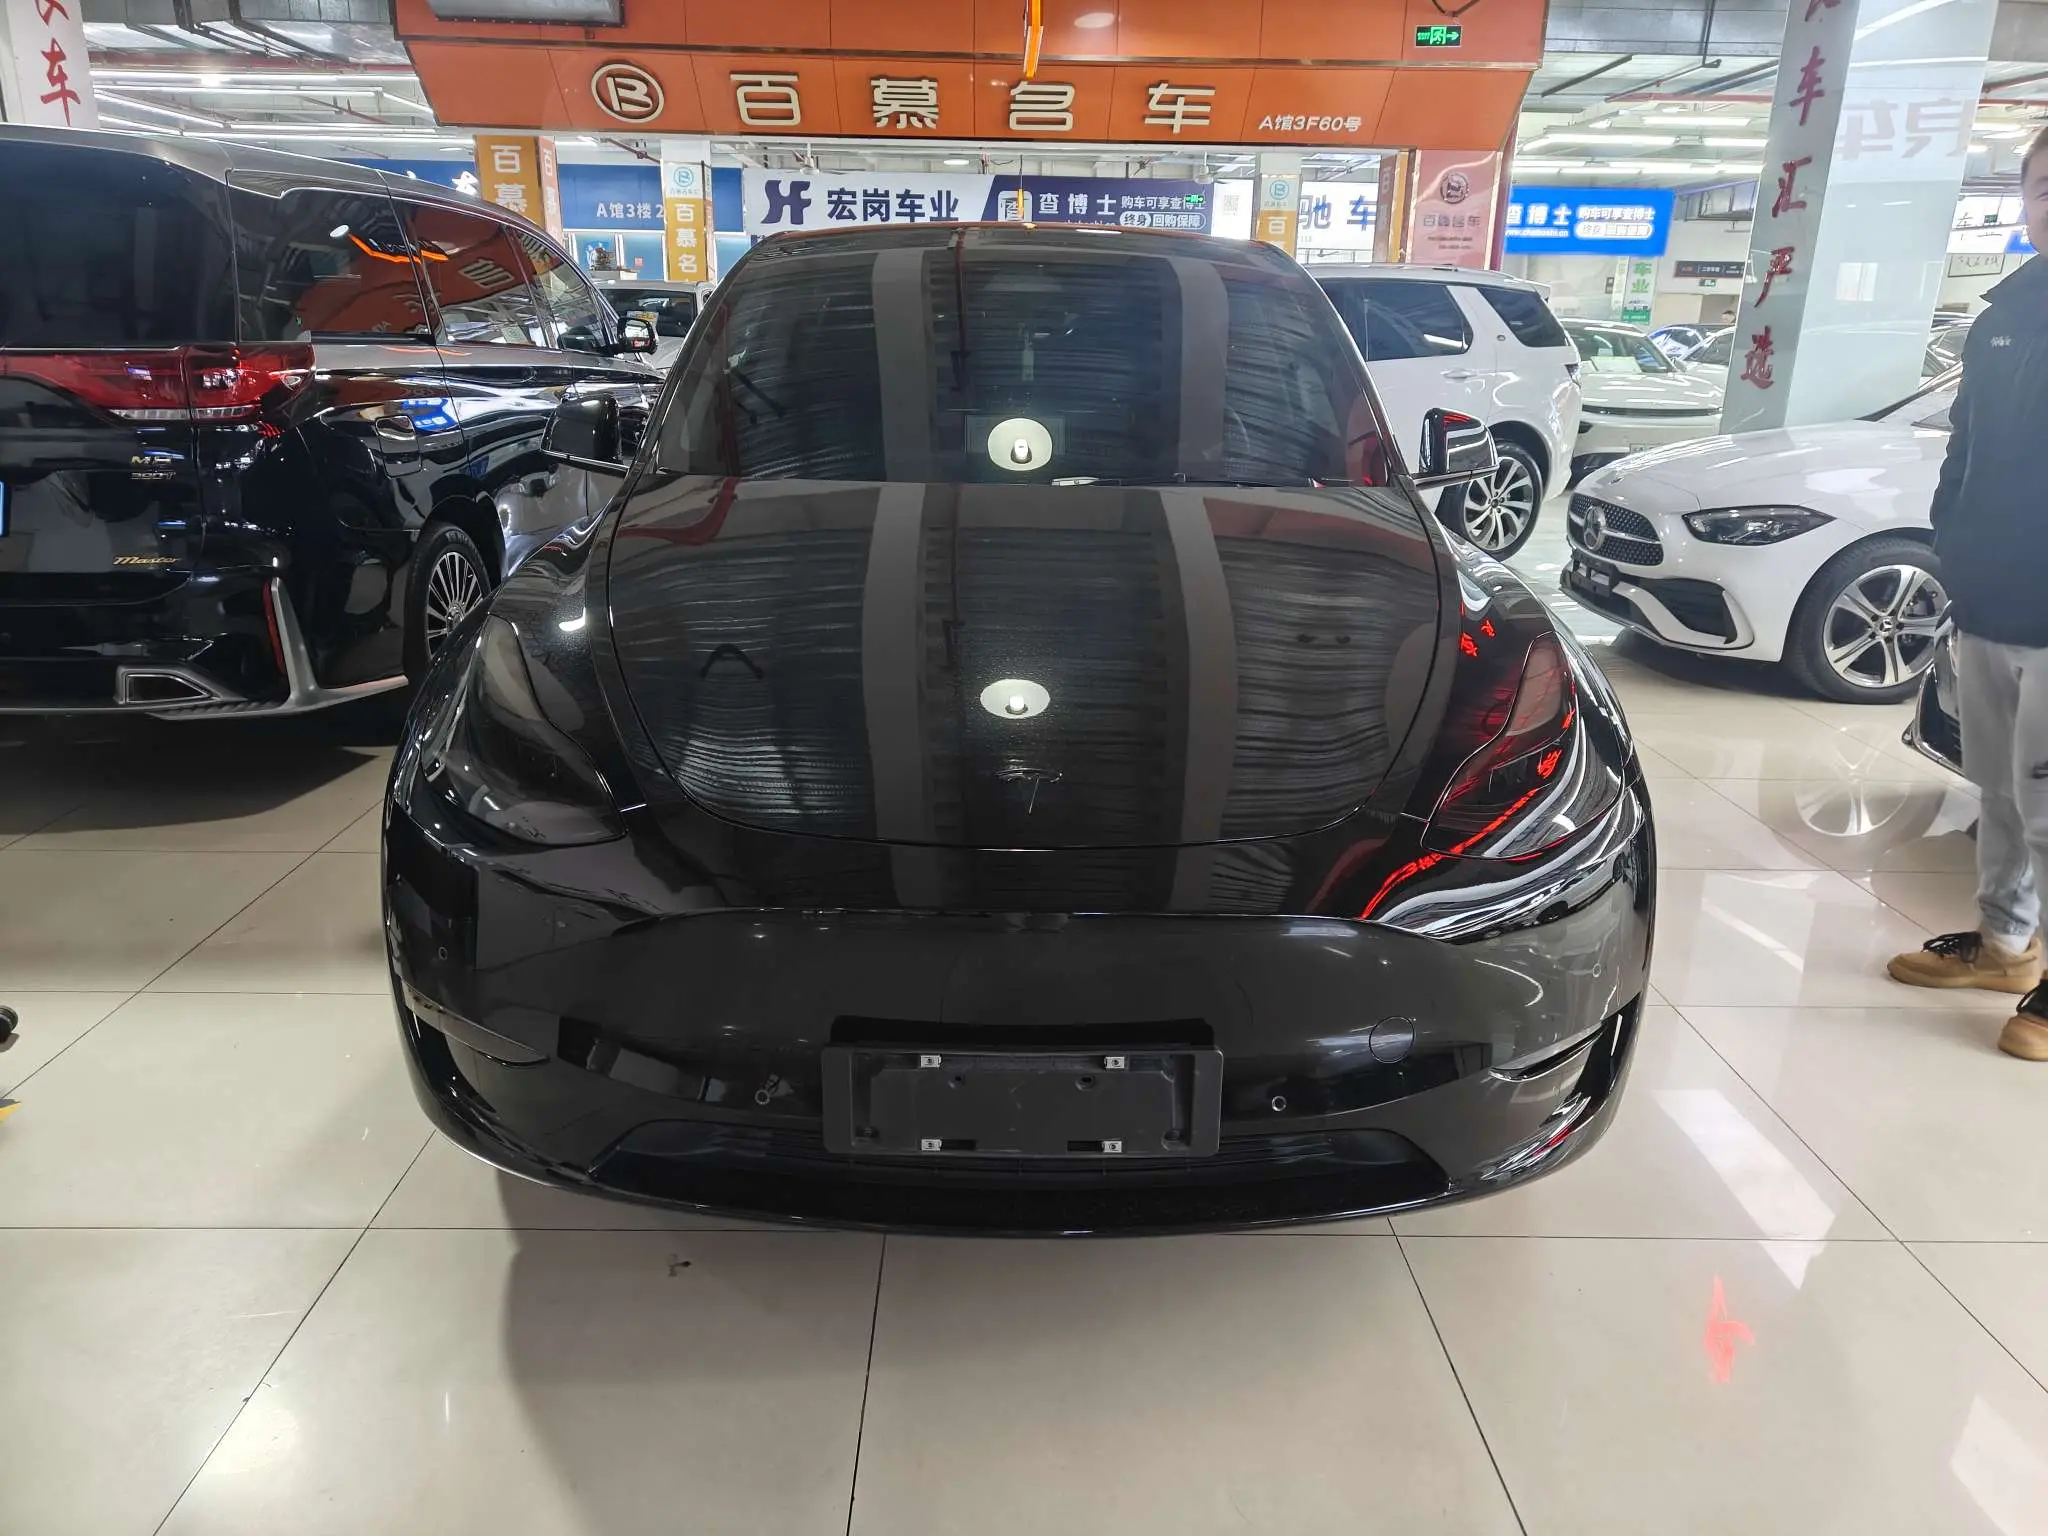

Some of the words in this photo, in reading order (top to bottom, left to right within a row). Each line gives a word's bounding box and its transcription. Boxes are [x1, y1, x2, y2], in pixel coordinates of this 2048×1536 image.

[1259, 115, 1362, 132] A馆3F60号
[596, 203, 651, 218] A馆3楼
[828, 188, 959, 222] 宏岗车业
[1039, 193, 1116, 215] 查博士
